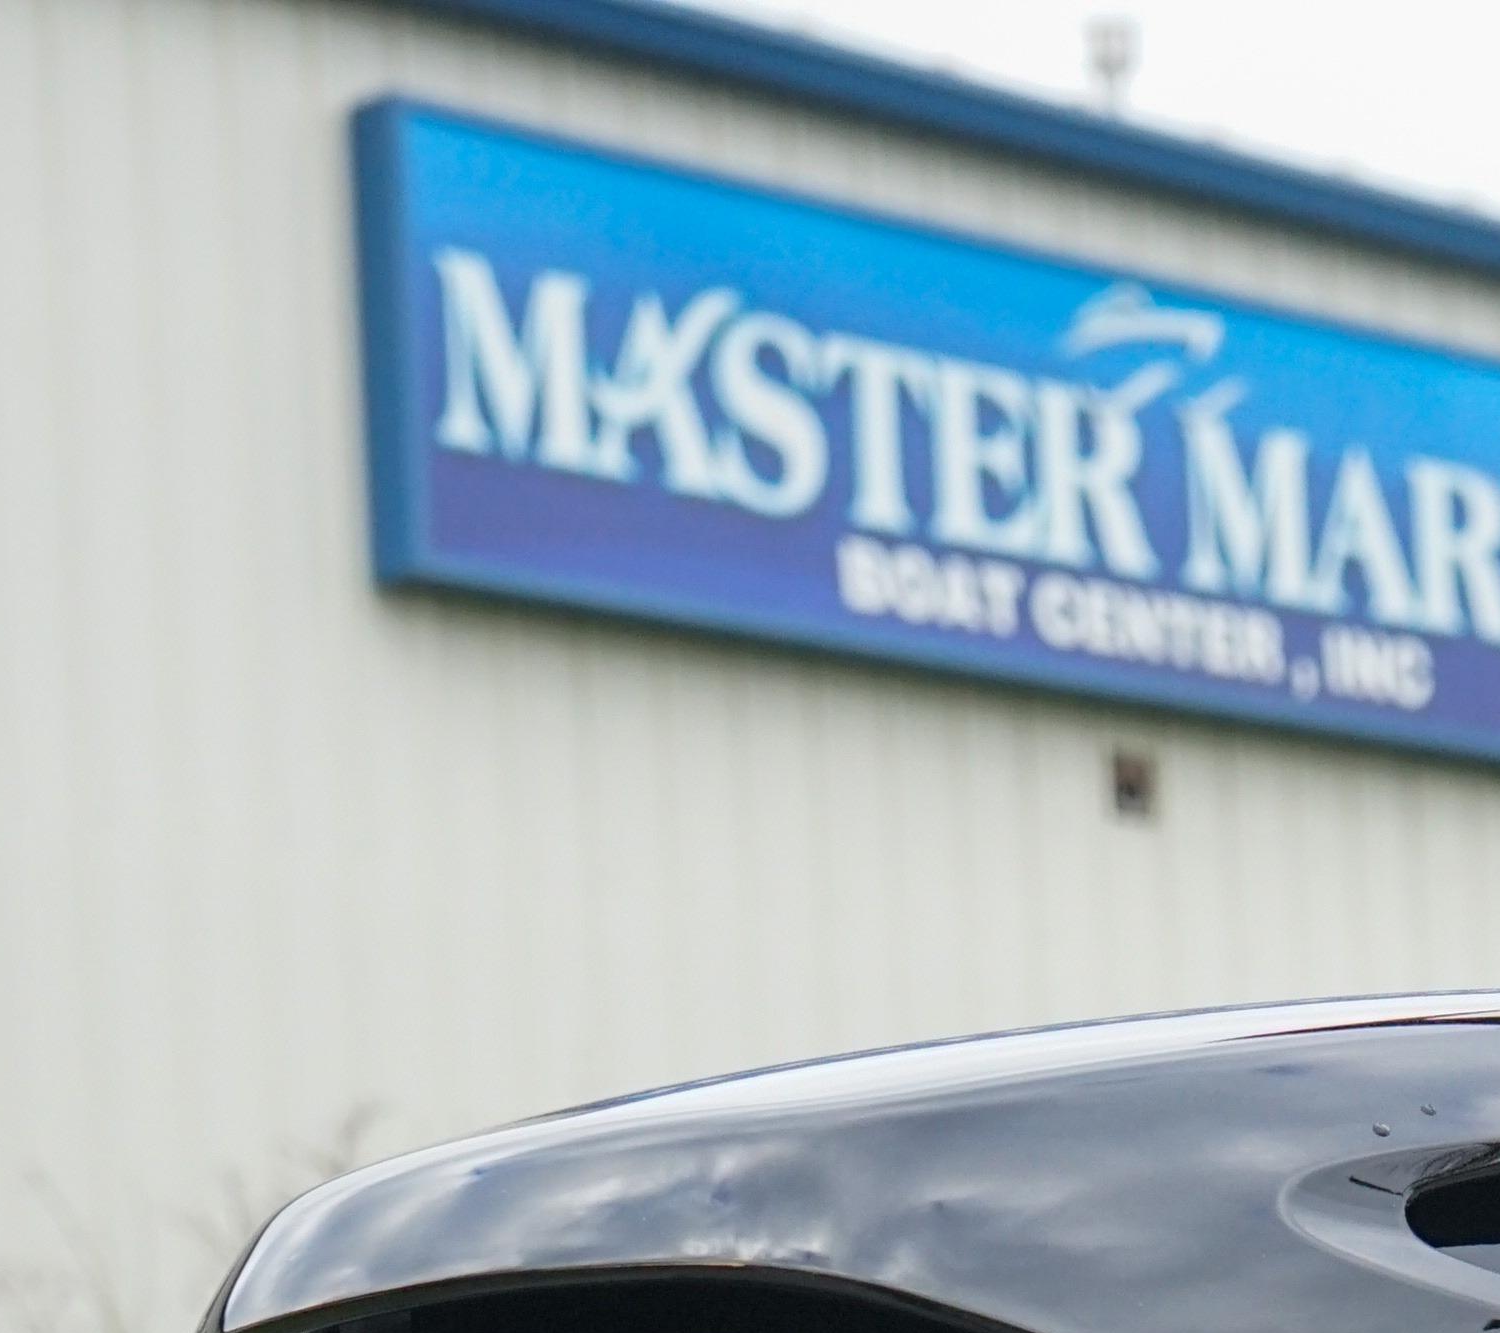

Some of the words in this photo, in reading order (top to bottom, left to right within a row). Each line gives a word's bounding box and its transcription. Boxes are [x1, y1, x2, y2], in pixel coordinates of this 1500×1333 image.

[435, 248, 1162, 580] MASTER
[840, 542, 1025, 638] BOAT
[1032, 578, 1280, 682] CENTER
[1322, 635, 1432, 708] INC
